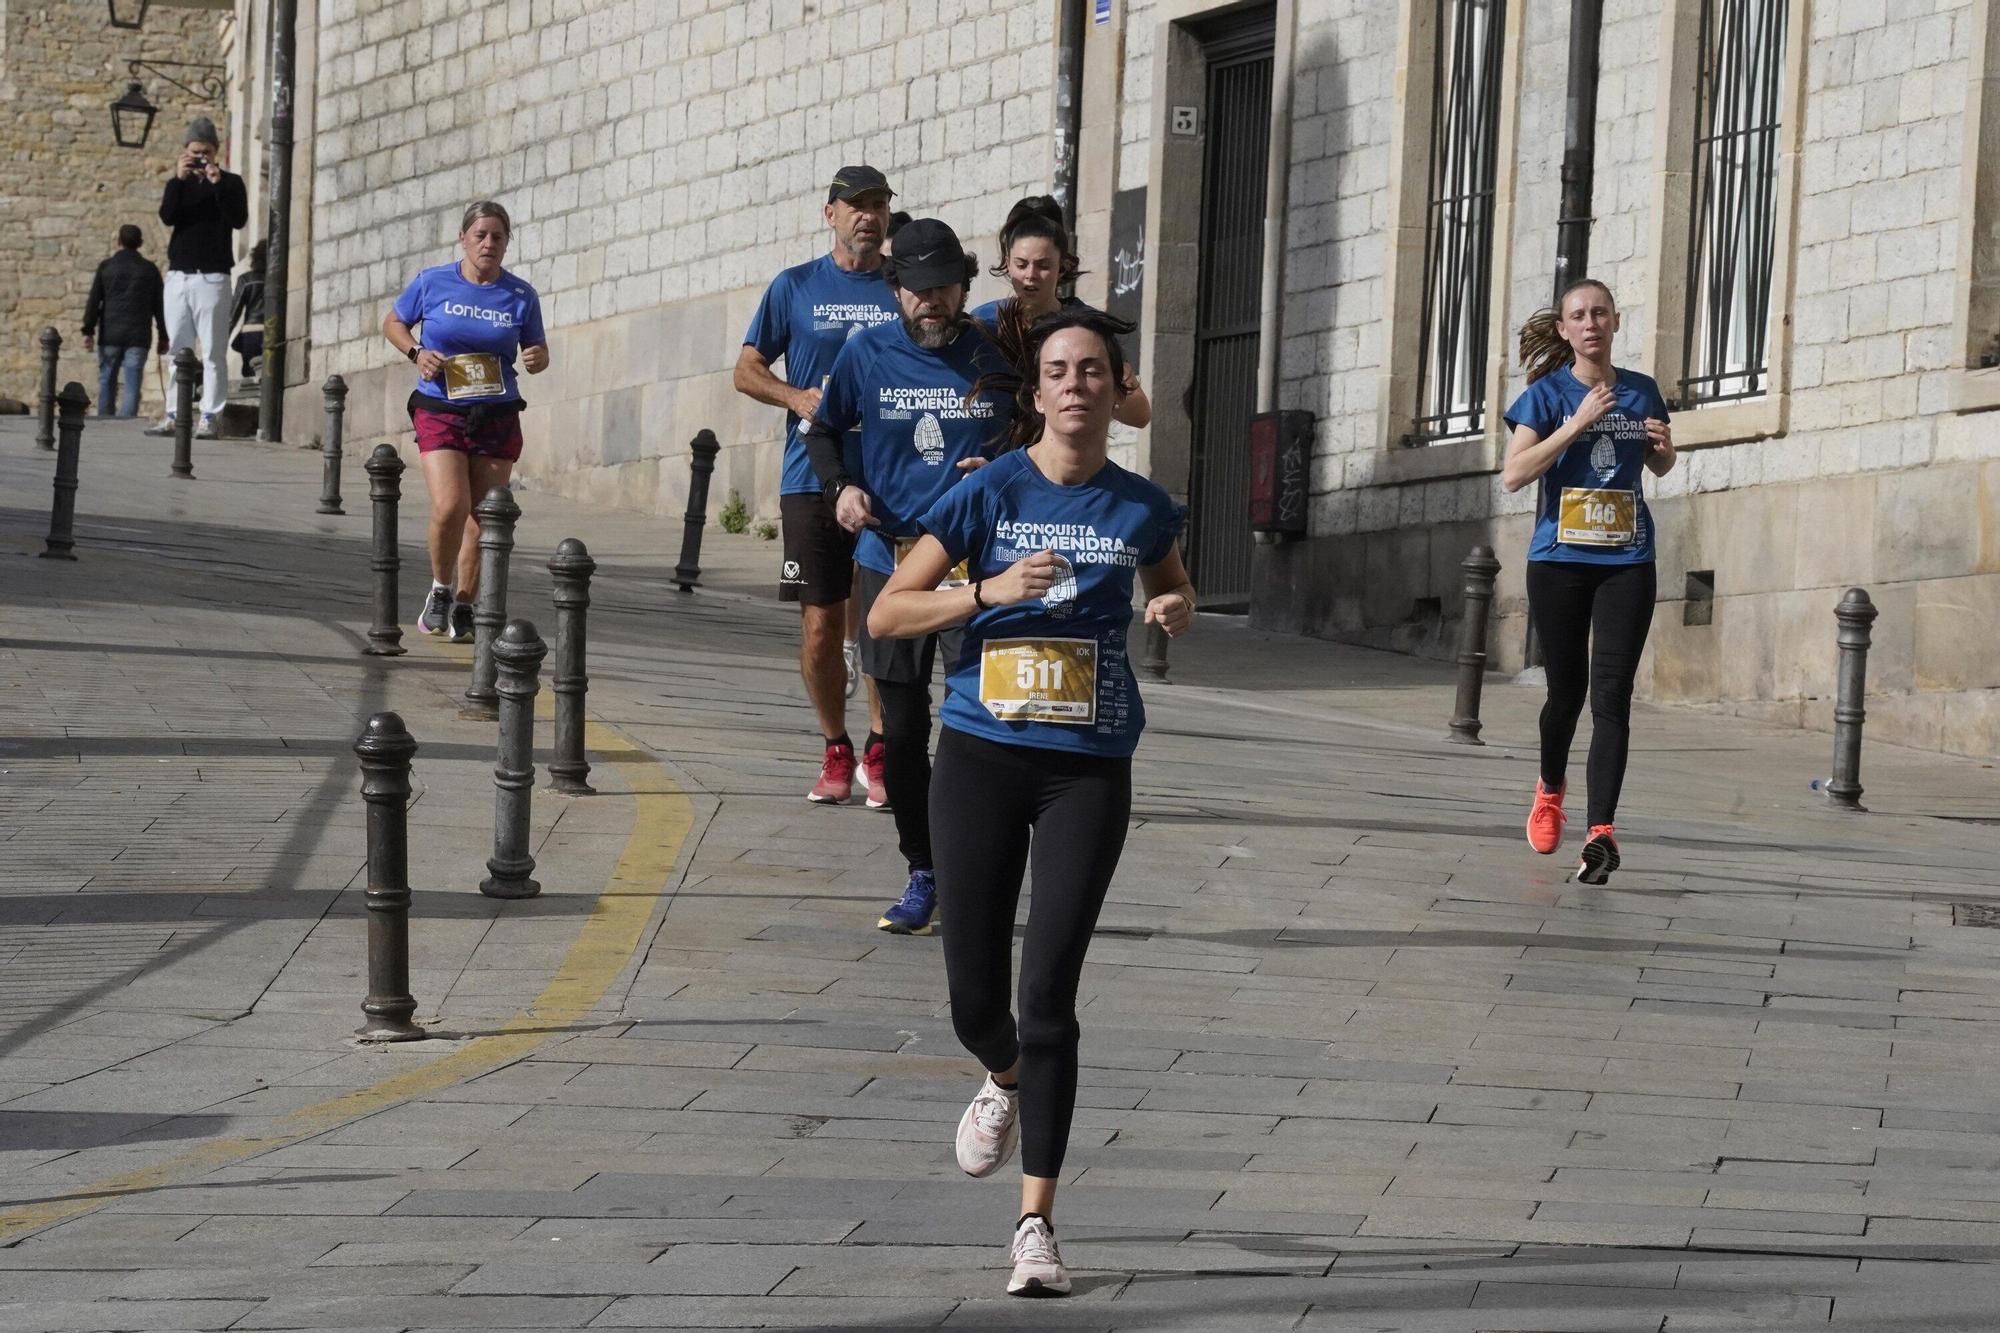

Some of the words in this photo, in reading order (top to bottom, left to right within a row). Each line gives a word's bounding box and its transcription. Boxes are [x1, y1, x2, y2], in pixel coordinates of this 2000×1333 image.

[444, 301, 512, 323] Lontana
[826, 304, 881, 313] CONQUISTA
[828, 311, 900, 321] ALMENDRA
[465, 364, 486, 381] 53
[880, 388, 893, 396] LA
[893, 388, 956, 398] CONQUISTA
[1582, 503, 1616, 524] 146
[996, 520, 1012, 532] LA
[1012, 523, 1096, 537] CONQUISTA
[997, 531, 1005, 539] DE
[1006, 532, 1017, 540] LA
[1015, 534, 1126, 553] ALMENDRA
[1075, 552, 1137, 568] KONKISTA
[1016, 659, 1063, 690] 511
[1029, 691, 1049, 700] IRENE
